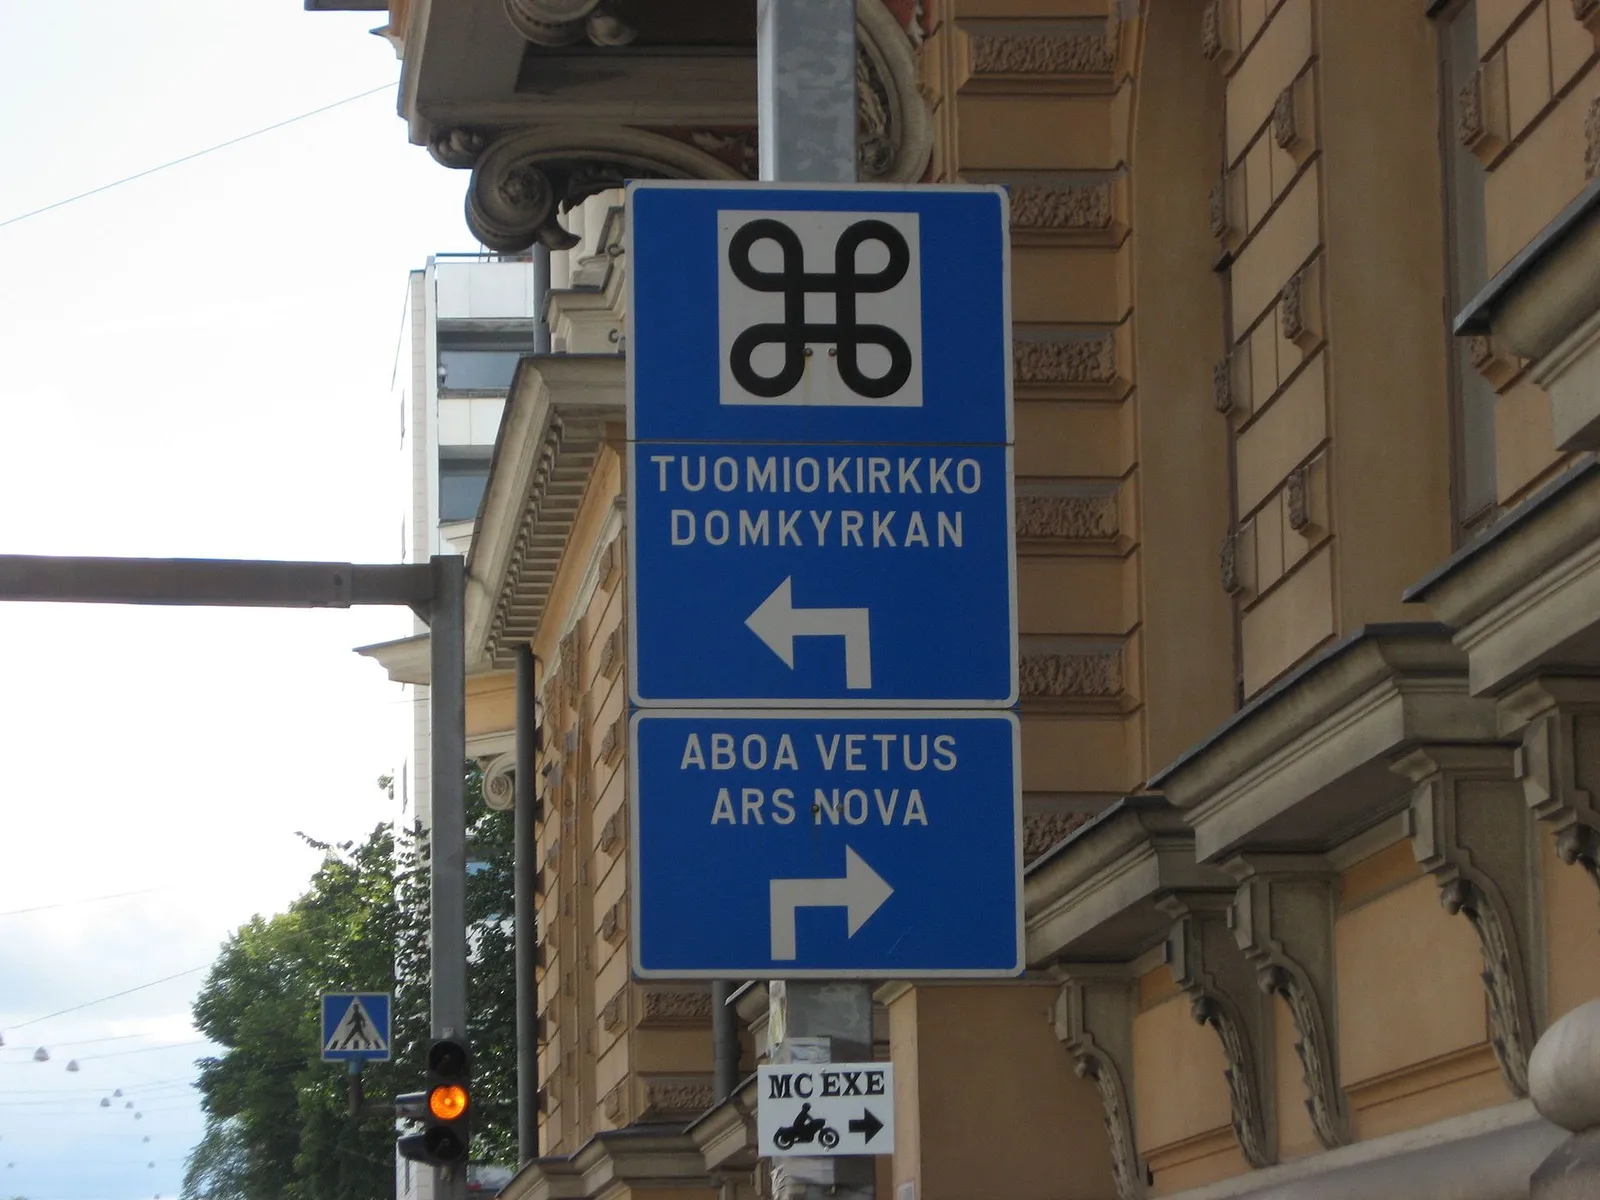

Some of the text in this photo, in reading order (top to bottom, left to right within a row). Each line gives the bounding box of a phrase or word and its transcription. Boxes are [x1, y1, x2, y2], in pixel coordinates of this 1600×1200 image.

[651, 456, 981, 493] TUOMIOKIRKKO
[671, 509, 963, 547] DOMKYRKAN
[680, 733, 958, 771] ABOA VETUS
[710, 787, 928, 826] ARS NOVA
[768, 1070, 885, 1099] MC EXE
